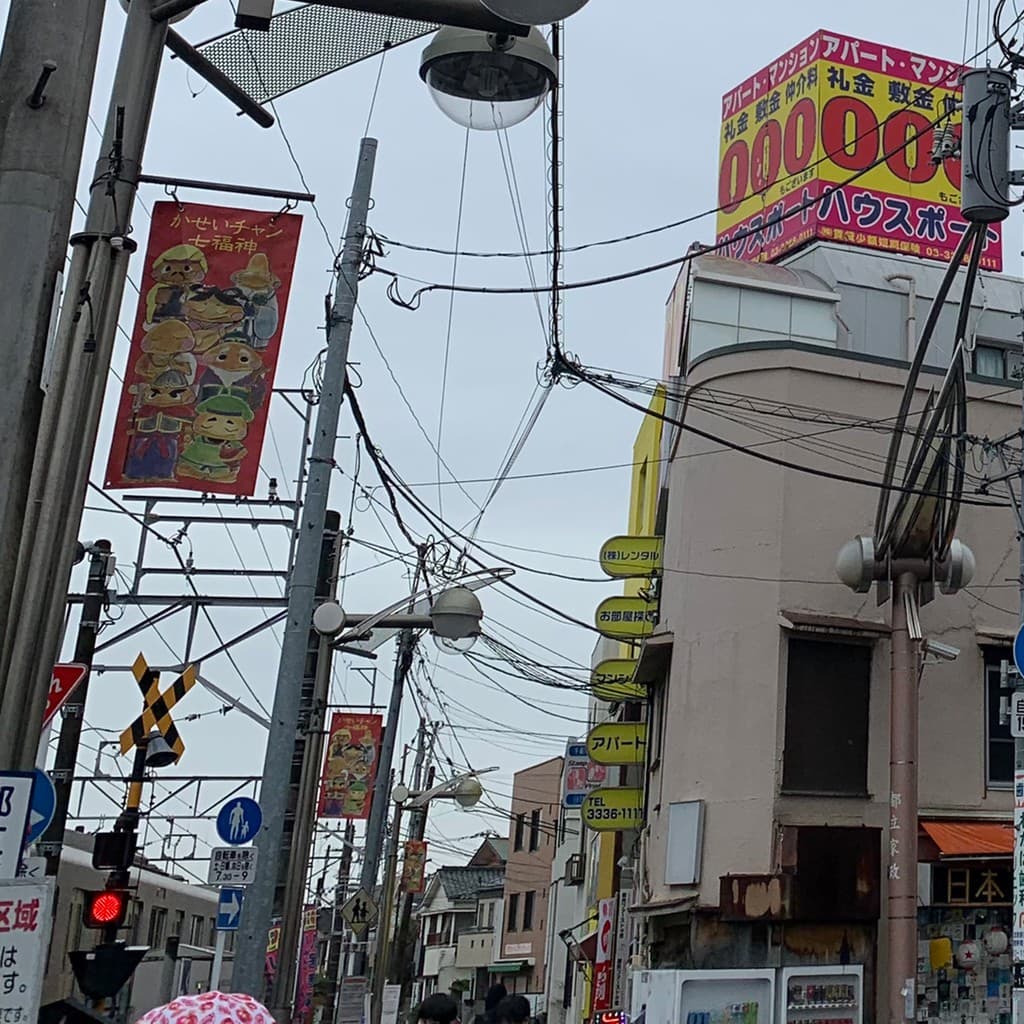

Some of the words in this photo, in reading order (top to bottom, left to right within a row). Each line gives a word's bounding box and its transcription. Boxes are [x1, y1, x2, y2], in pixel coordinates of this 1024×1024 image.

[827, 65, 875, 97] 礼金
[888, 79, 935, 110] 敷金
[724, 113, 749, 143] 礼金
[169, 215, 284, 238] かせいチャン
[188, 235, 259, 254] 七福神
[592, 737, 646, 750] アパート
[588, 797, 606, 807] TEL
